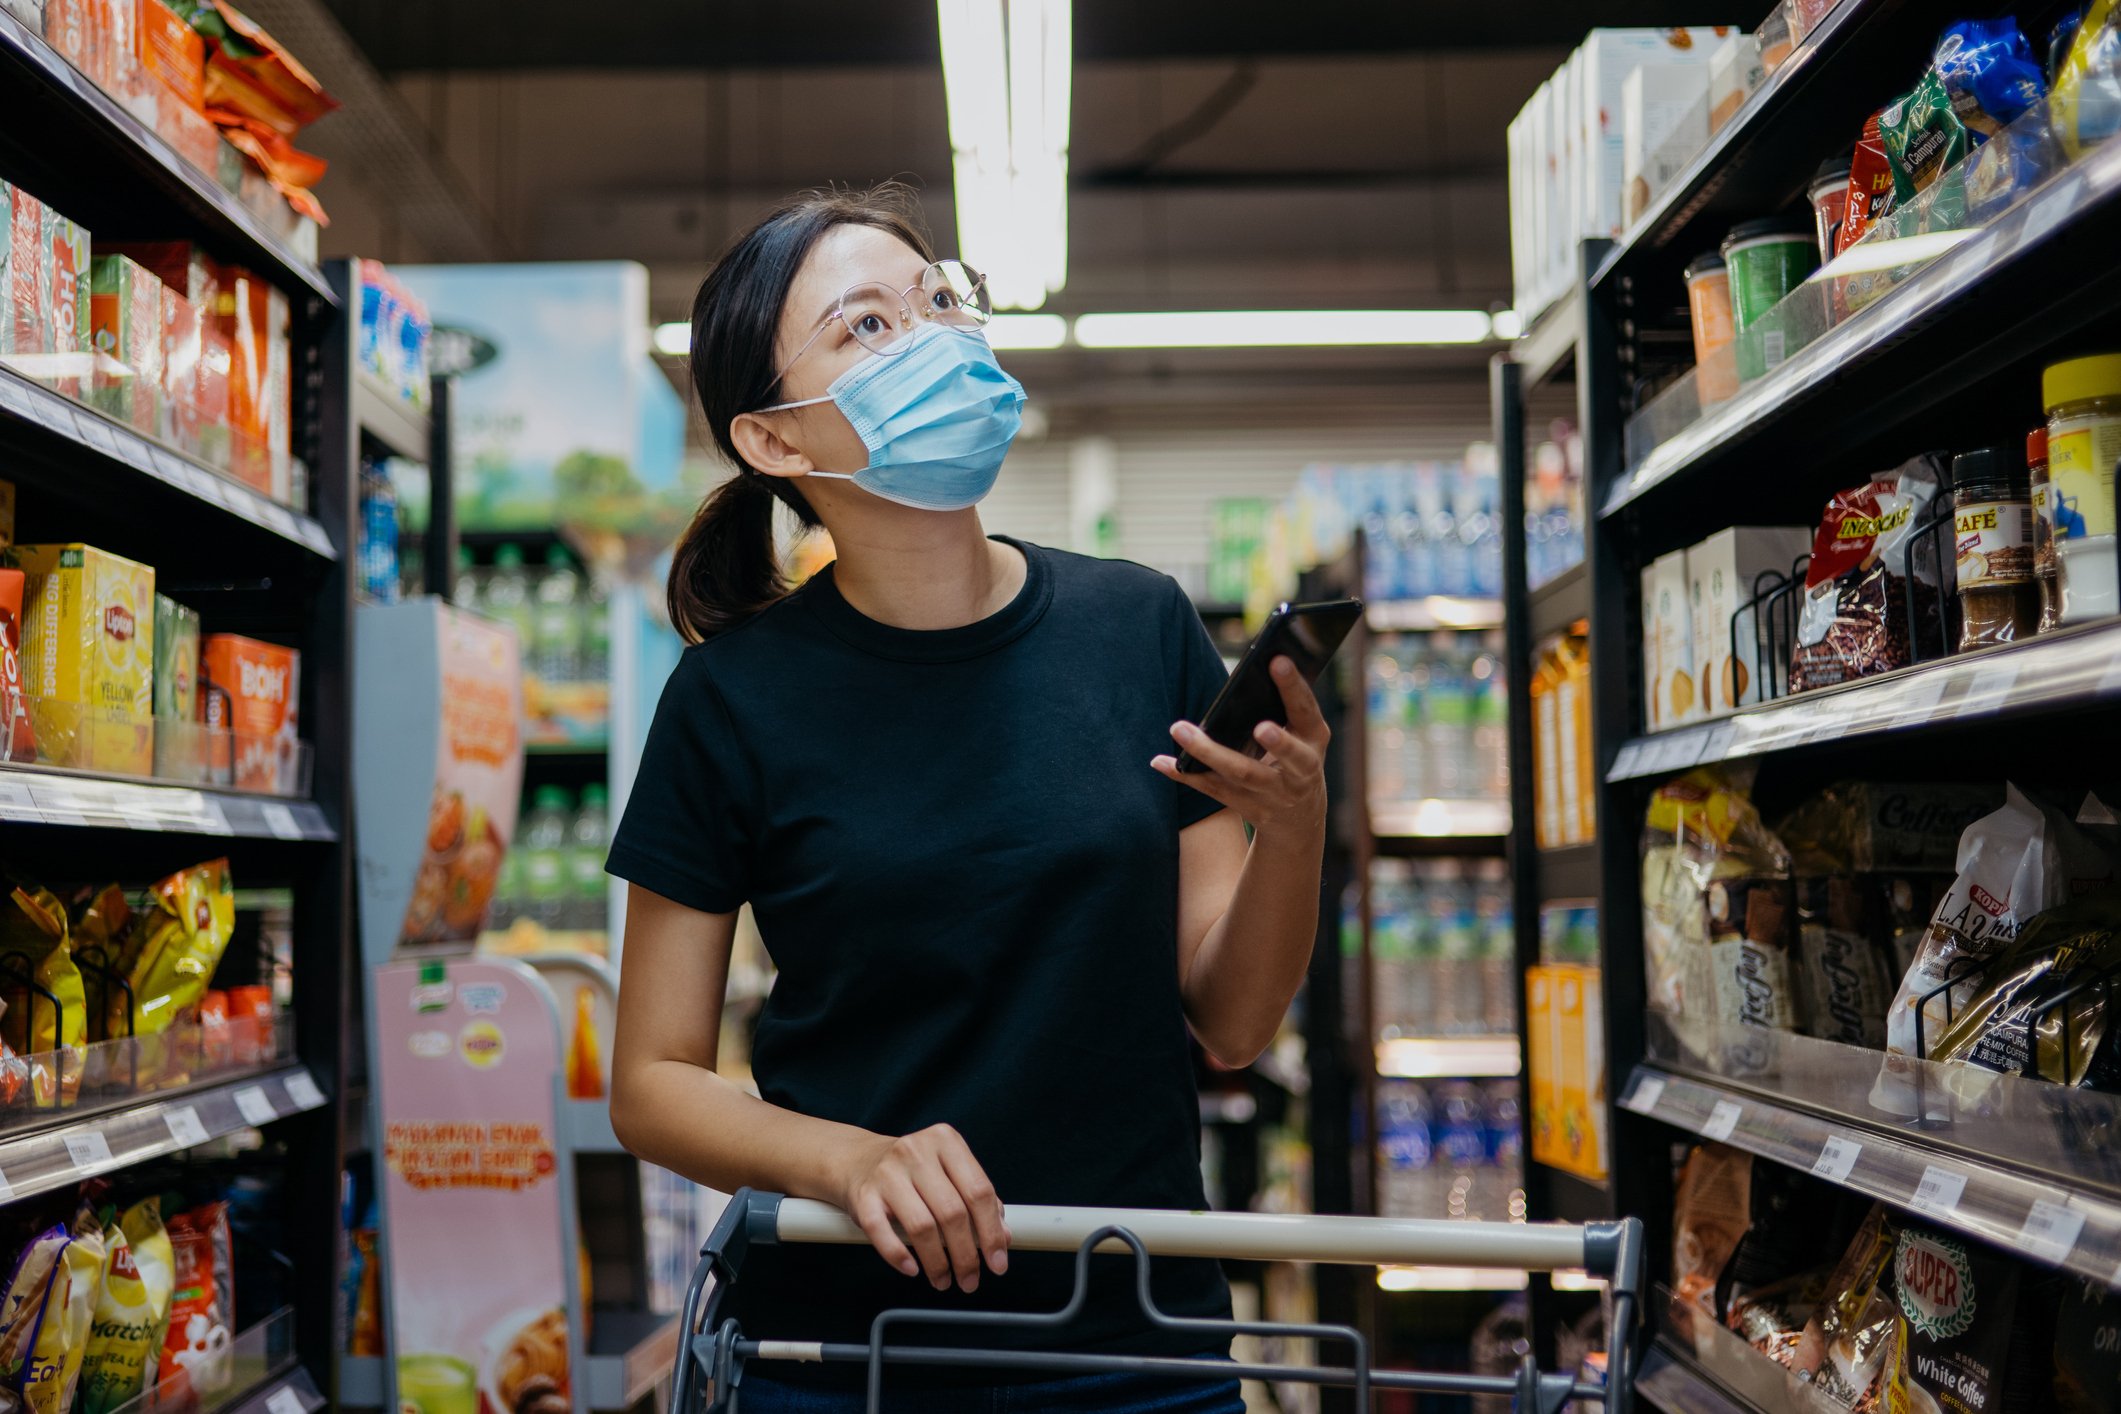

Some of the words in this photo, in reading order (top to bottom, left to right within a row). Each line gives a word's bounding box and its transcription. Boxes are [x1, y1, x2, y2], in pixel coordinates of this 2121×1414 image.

[1907, 130, 1948, 165] Campuran
[106, 609, 134, 636] Lipton
[43, 604, 58, 697] DIFFERENCE
[101, 679, 134, 702] YELLOW
[2005, 1045, 2029, 1063] COFFEE
[1904, 1246, 1958, 1308] SUPER
[1917, 1354, 1956, 1388] White
[1957, 1375, 1985, 1409] Coffee
